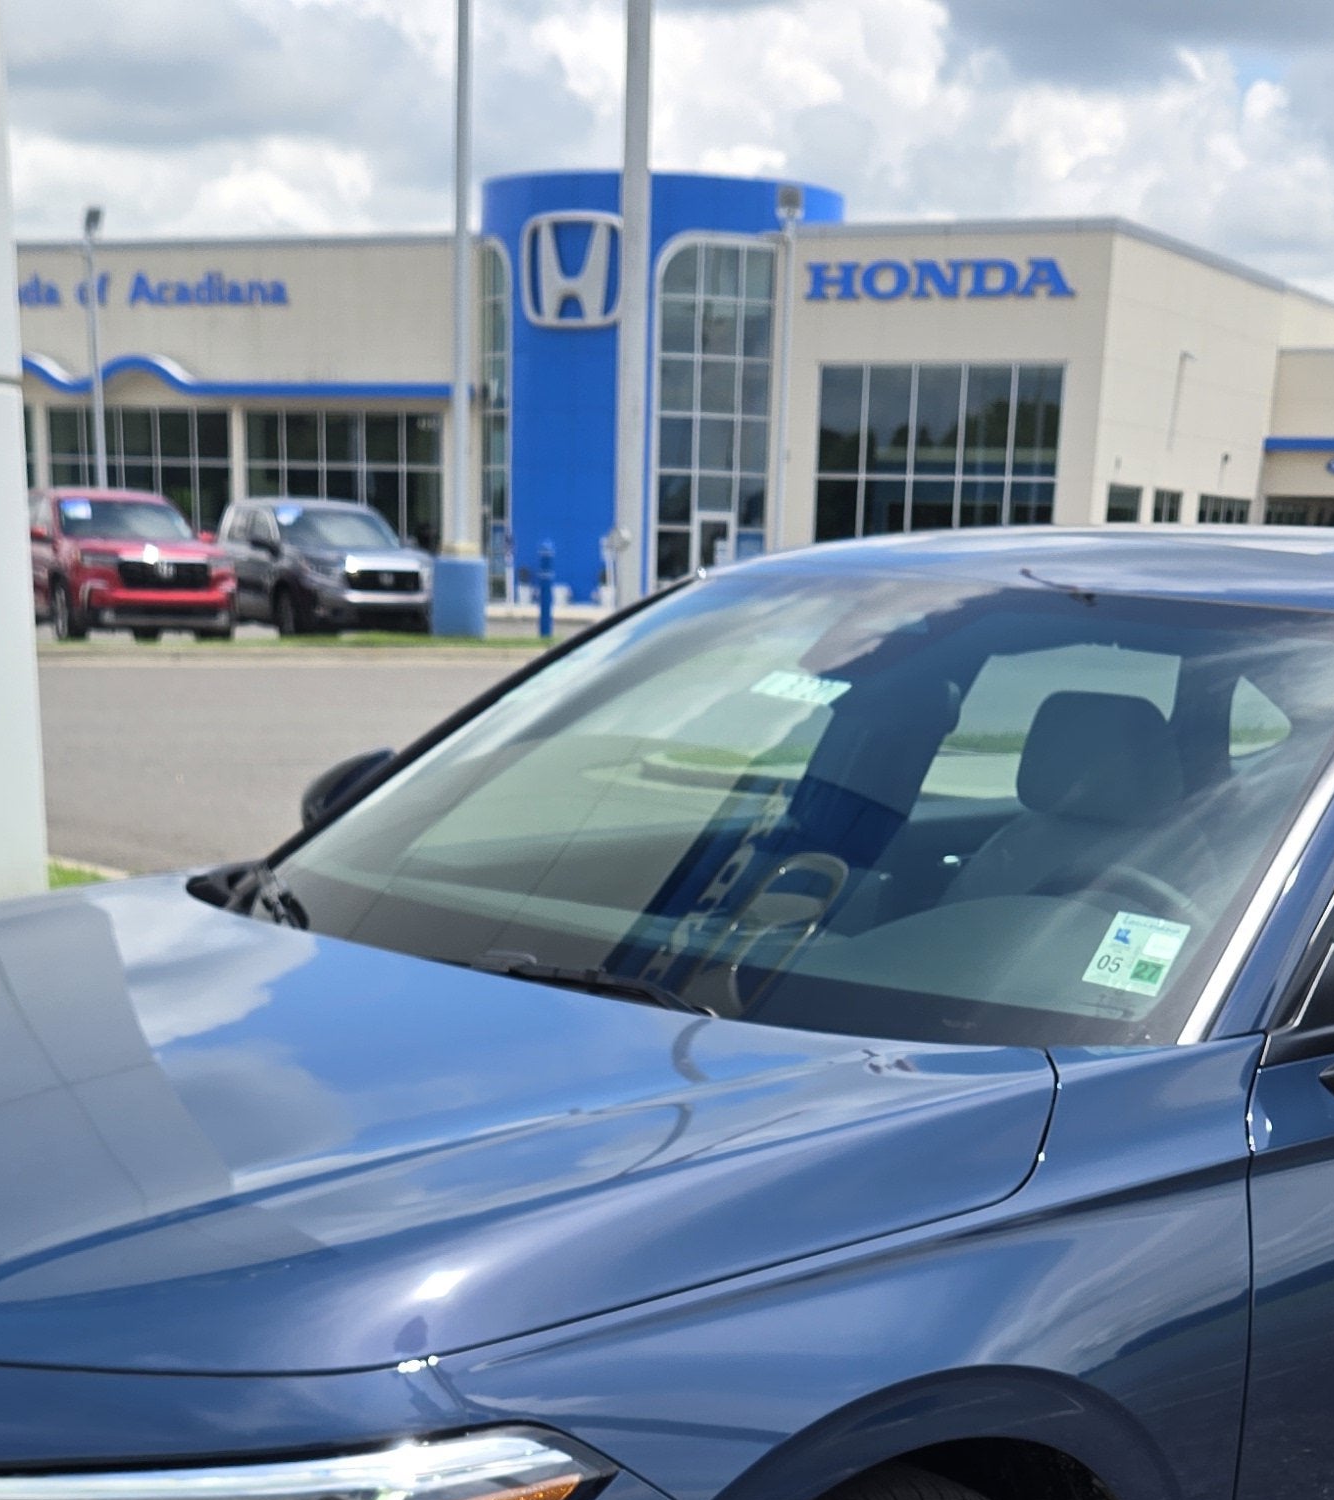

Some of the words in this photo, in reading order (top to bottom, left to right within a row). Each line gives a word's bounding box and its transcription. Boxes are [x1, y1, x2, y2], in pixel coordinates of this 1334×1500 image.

[75, 272, 110, 306] of
[128, 271, 289, 306] Acadiana
[805, 257, 1076, 301] HONDA
[1096, 953, 1124, 974] 05
[1133, 962, 1164, 981] 27
